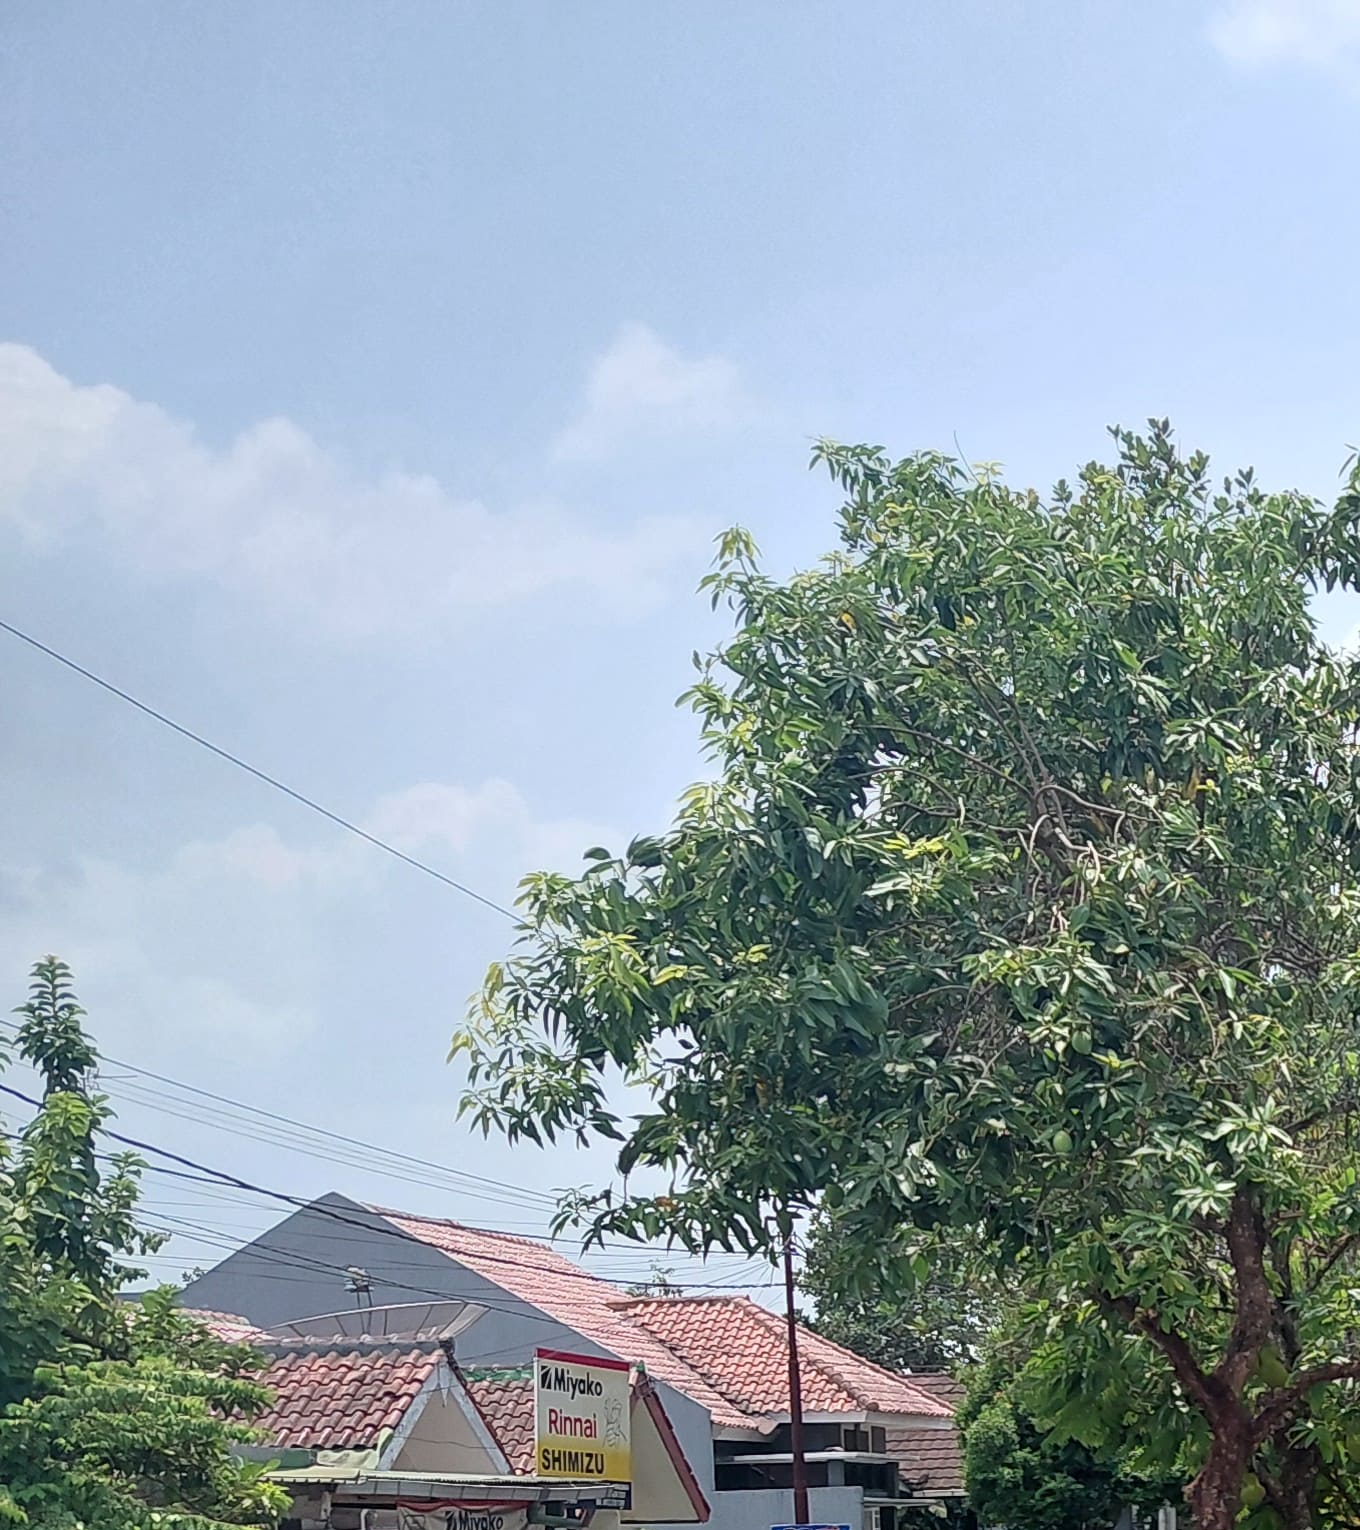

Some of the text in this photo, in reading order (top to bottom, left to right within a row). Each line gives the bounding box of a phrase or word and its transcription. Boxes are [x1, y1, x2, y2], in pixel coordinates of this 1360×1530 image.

[553, 1367, 603, 1400] Miyako
[548, 1408, 598, 1439] Rinnai
[541, 1448, 605, 1475] SHIMIZU
